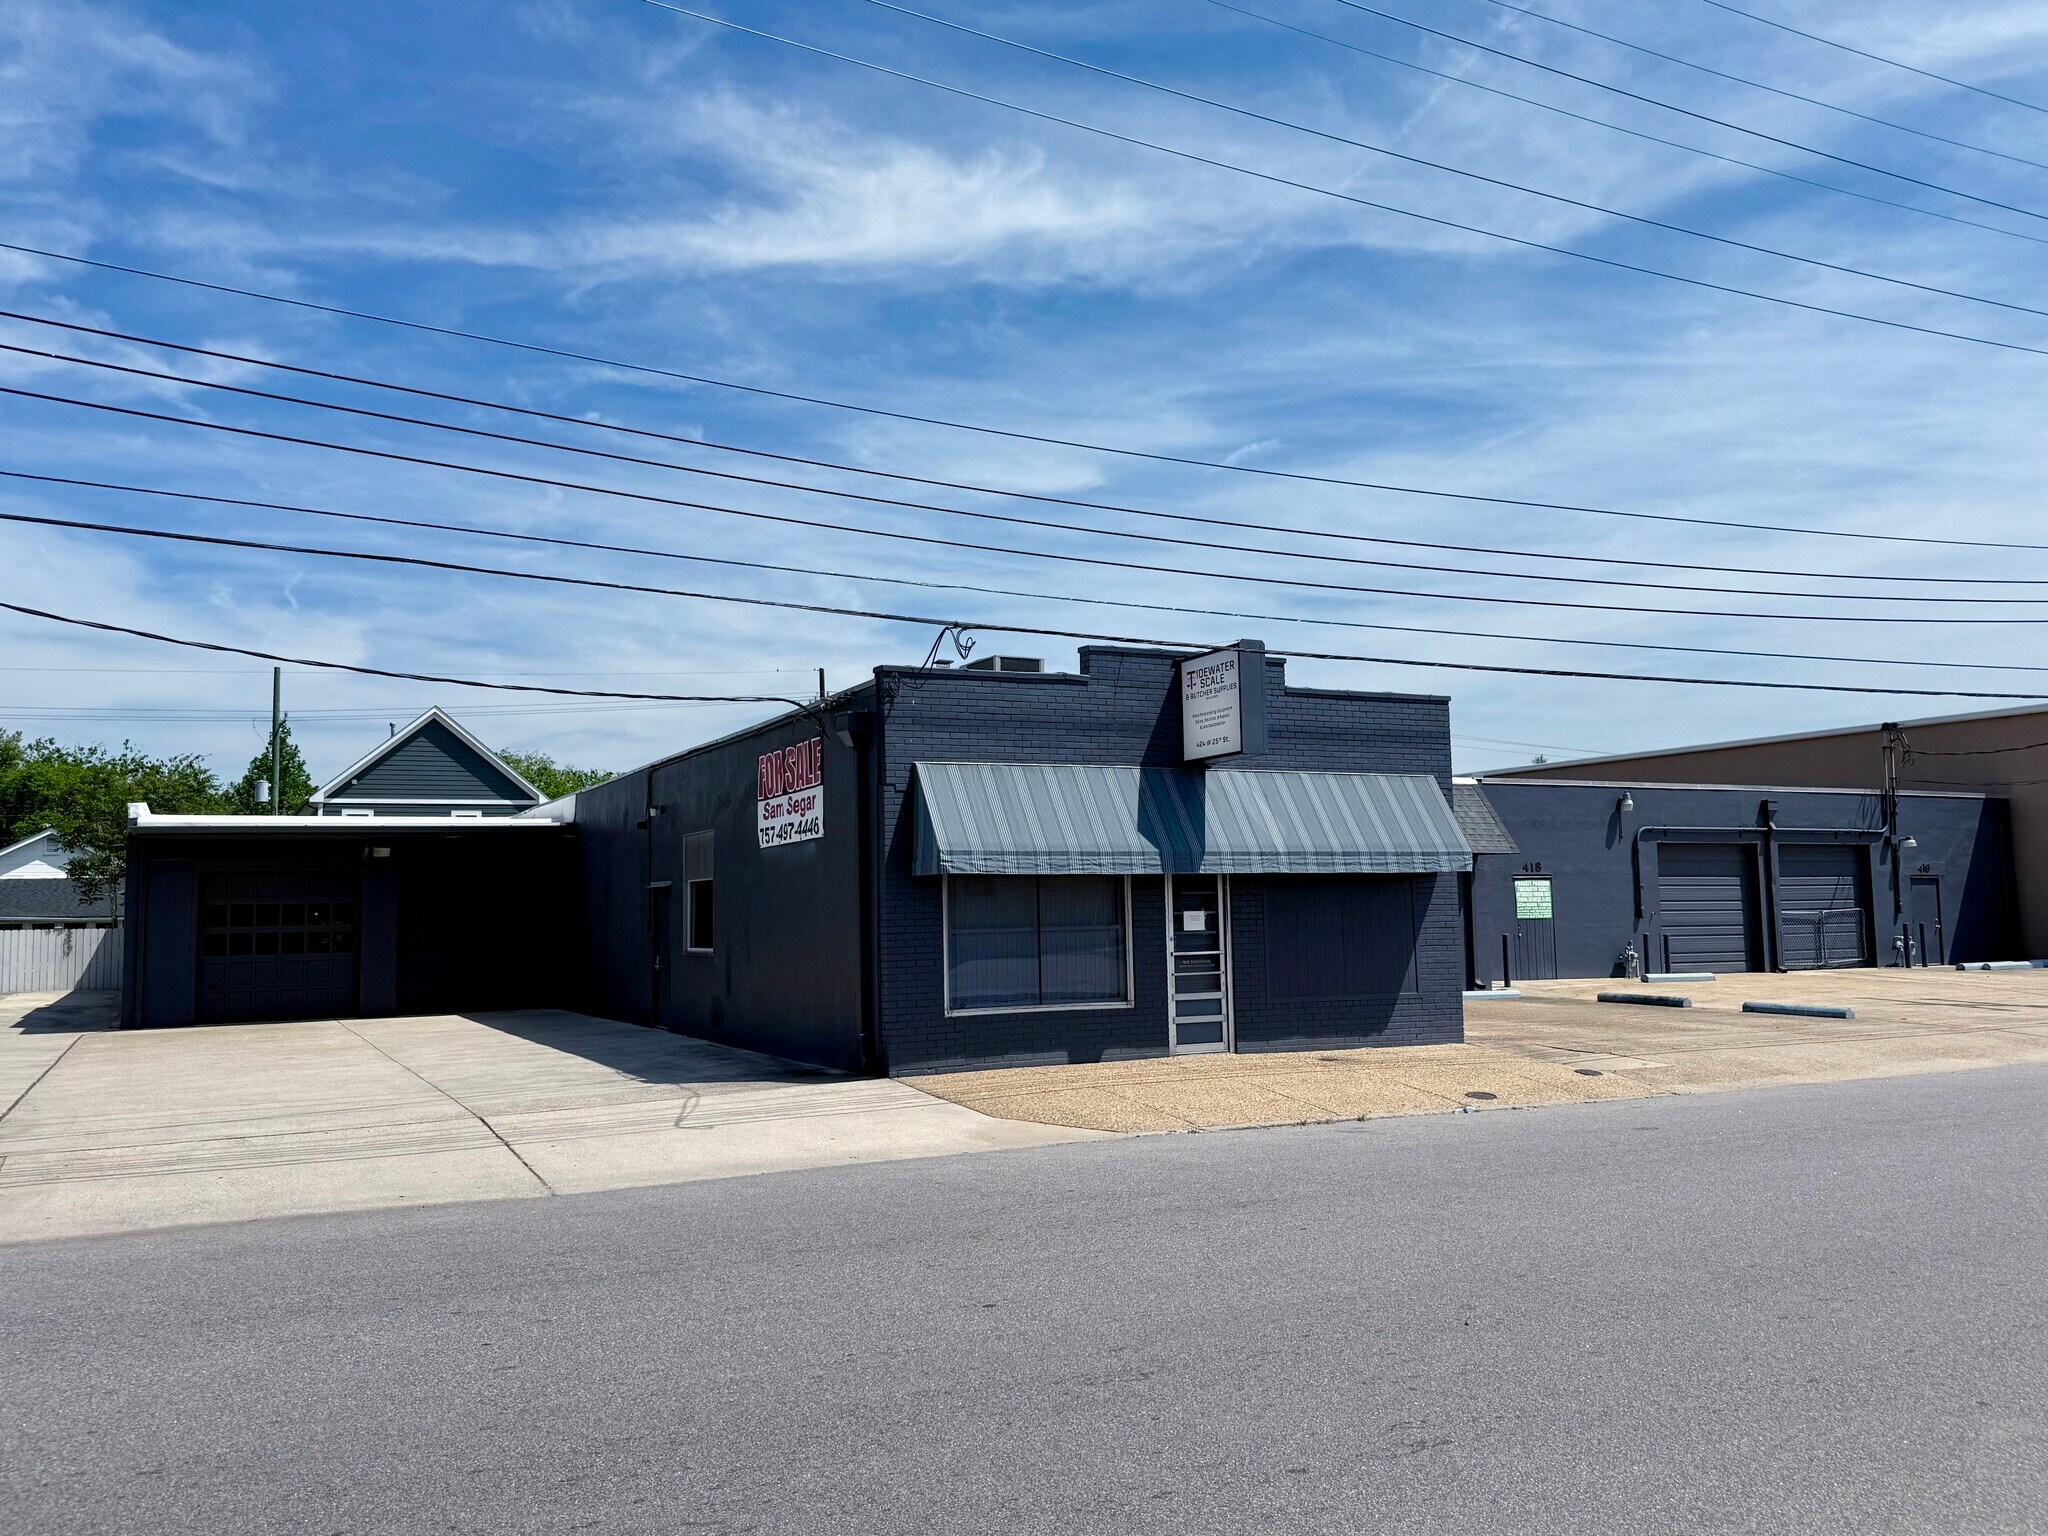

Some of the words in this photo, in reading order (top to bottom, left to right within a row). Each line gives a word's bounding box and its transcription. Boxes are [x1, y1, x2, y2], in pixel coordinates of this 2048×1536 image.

[1187, 660, 1235, 689] TIDEWATER
[1200, 673, 1225, 689] SCALE
[1190, 687, 1213, 700] BUTCHER
[1213, 682, 1237, 695] SUPPLIES
[1196, 740, 1206, 748] 424
[758, 750, 784, 800] FOR
[784, 736, 822, 793] SALE
[763, 801, 784, 821] Sam
[786, 794, 817, 818] Segar
[760, 816, 820, 845] 757-497-4446
[1522, 861, 1542, 873] 418
